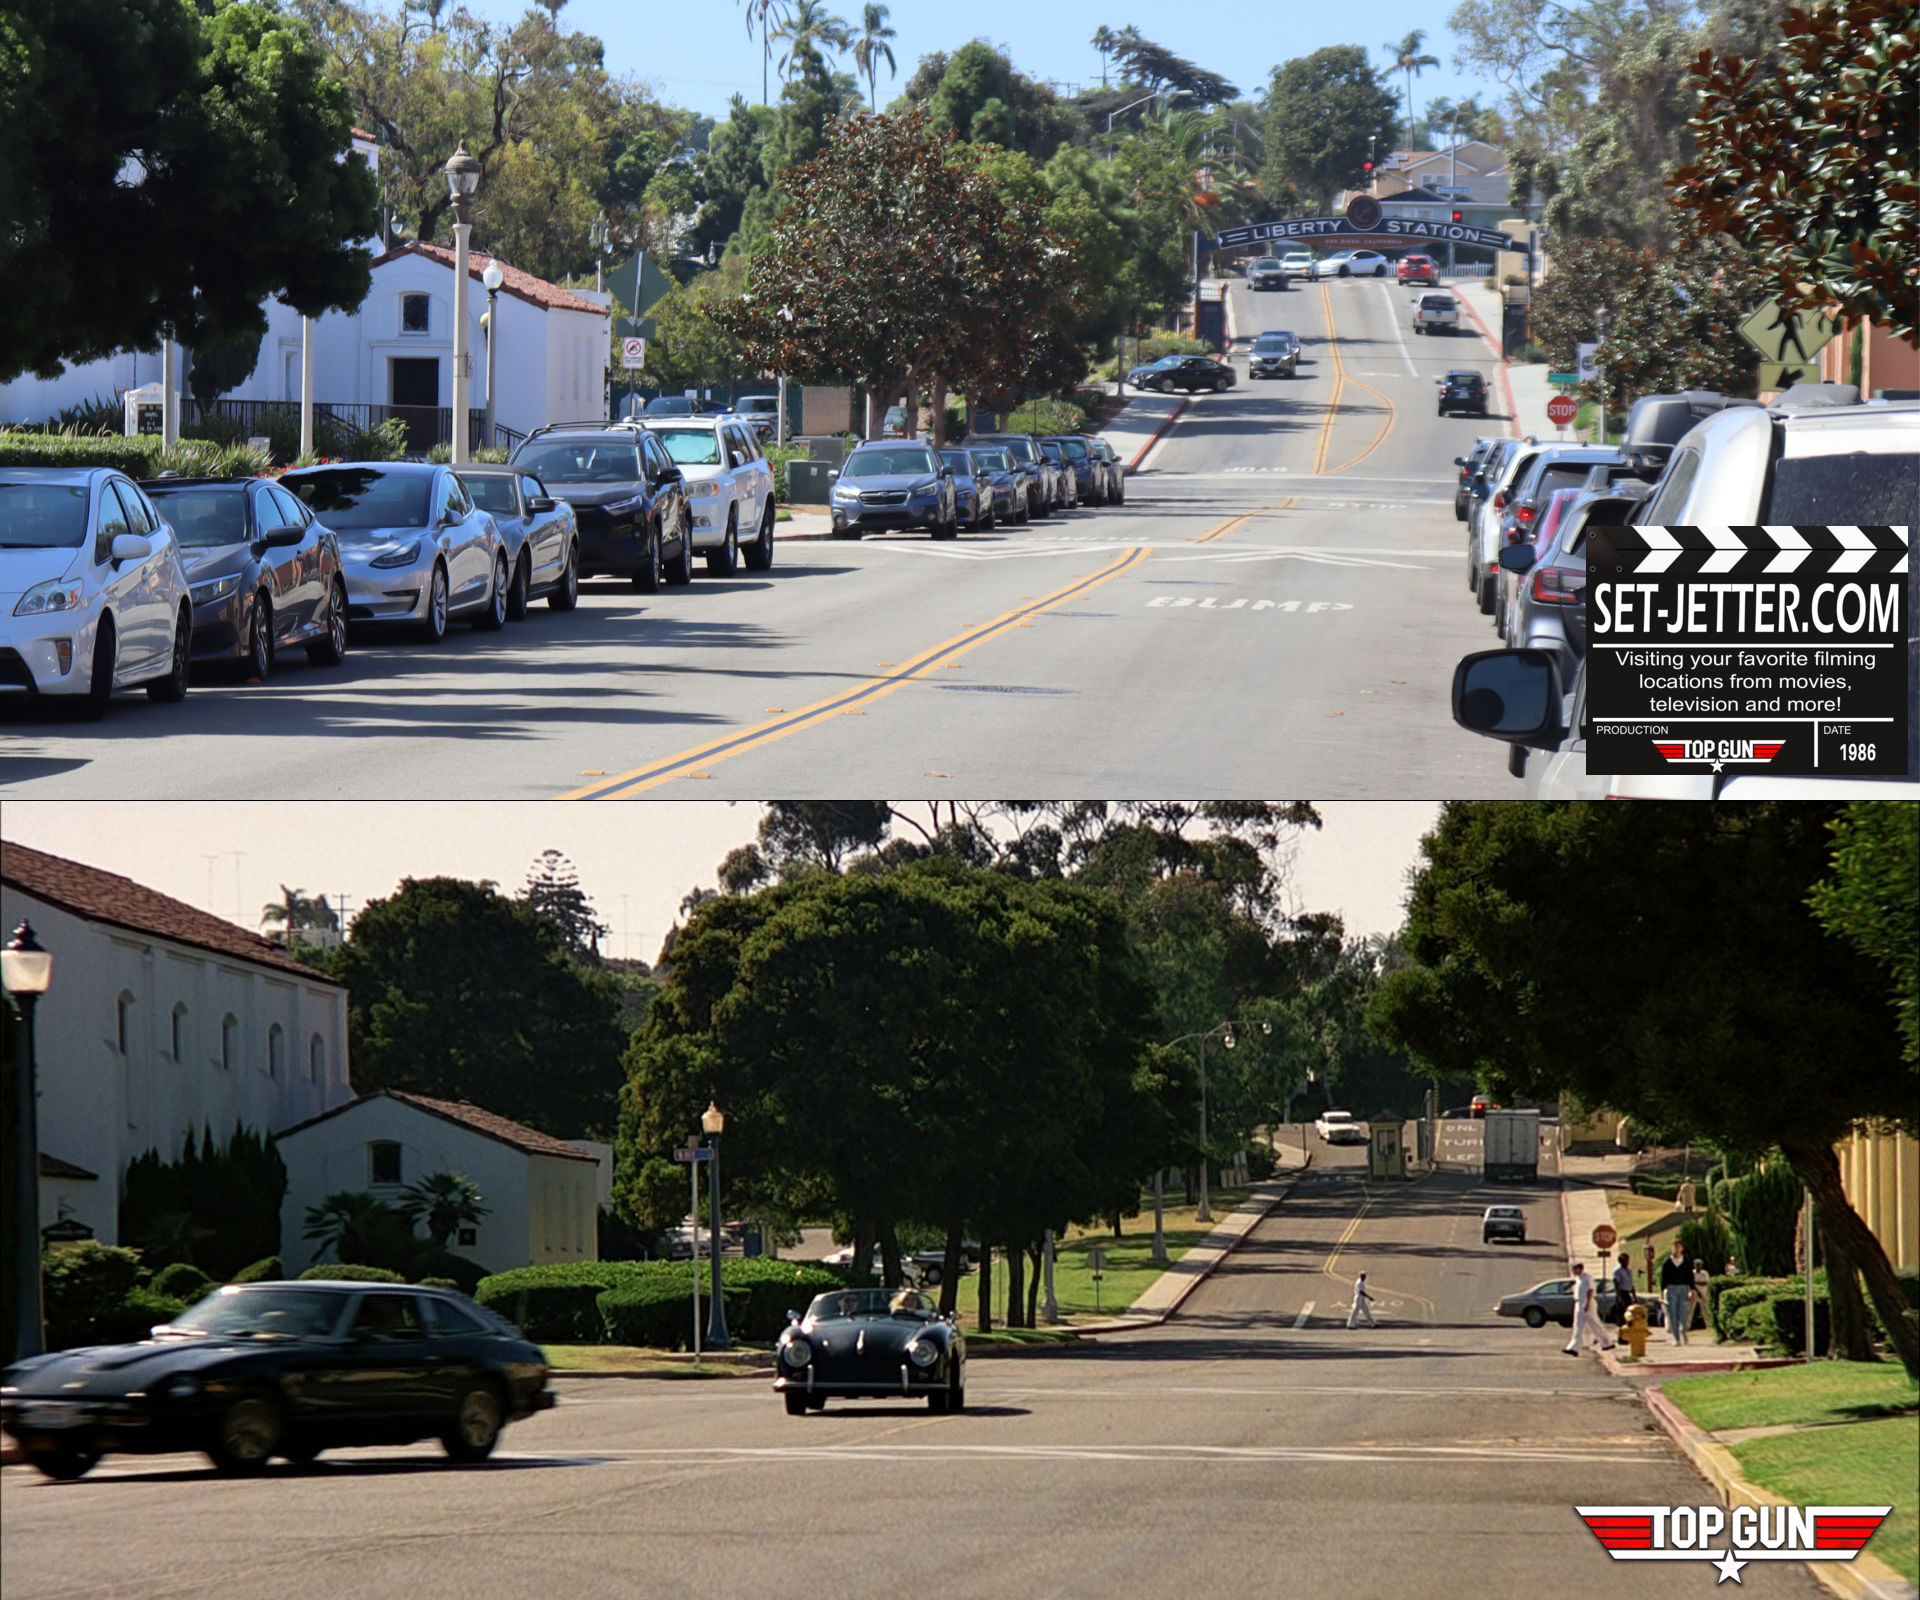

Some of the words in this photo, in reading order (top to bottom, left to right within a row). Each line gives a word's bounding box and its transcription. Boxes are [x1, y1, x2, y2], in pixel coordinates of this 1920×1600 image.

[1253, 220, 1343, 240] LIBERTY
[1387, 220, 1480, 242] STATION
[1549, 404, 1576, 416] STOP
[1145, 596, 1354, 613] BUMP
[1446, 1124, 1478, 1133] ONL
[1442, 1138, 1484, 1147] TUR
[1594, 1231, 1614, 1242] STOP
